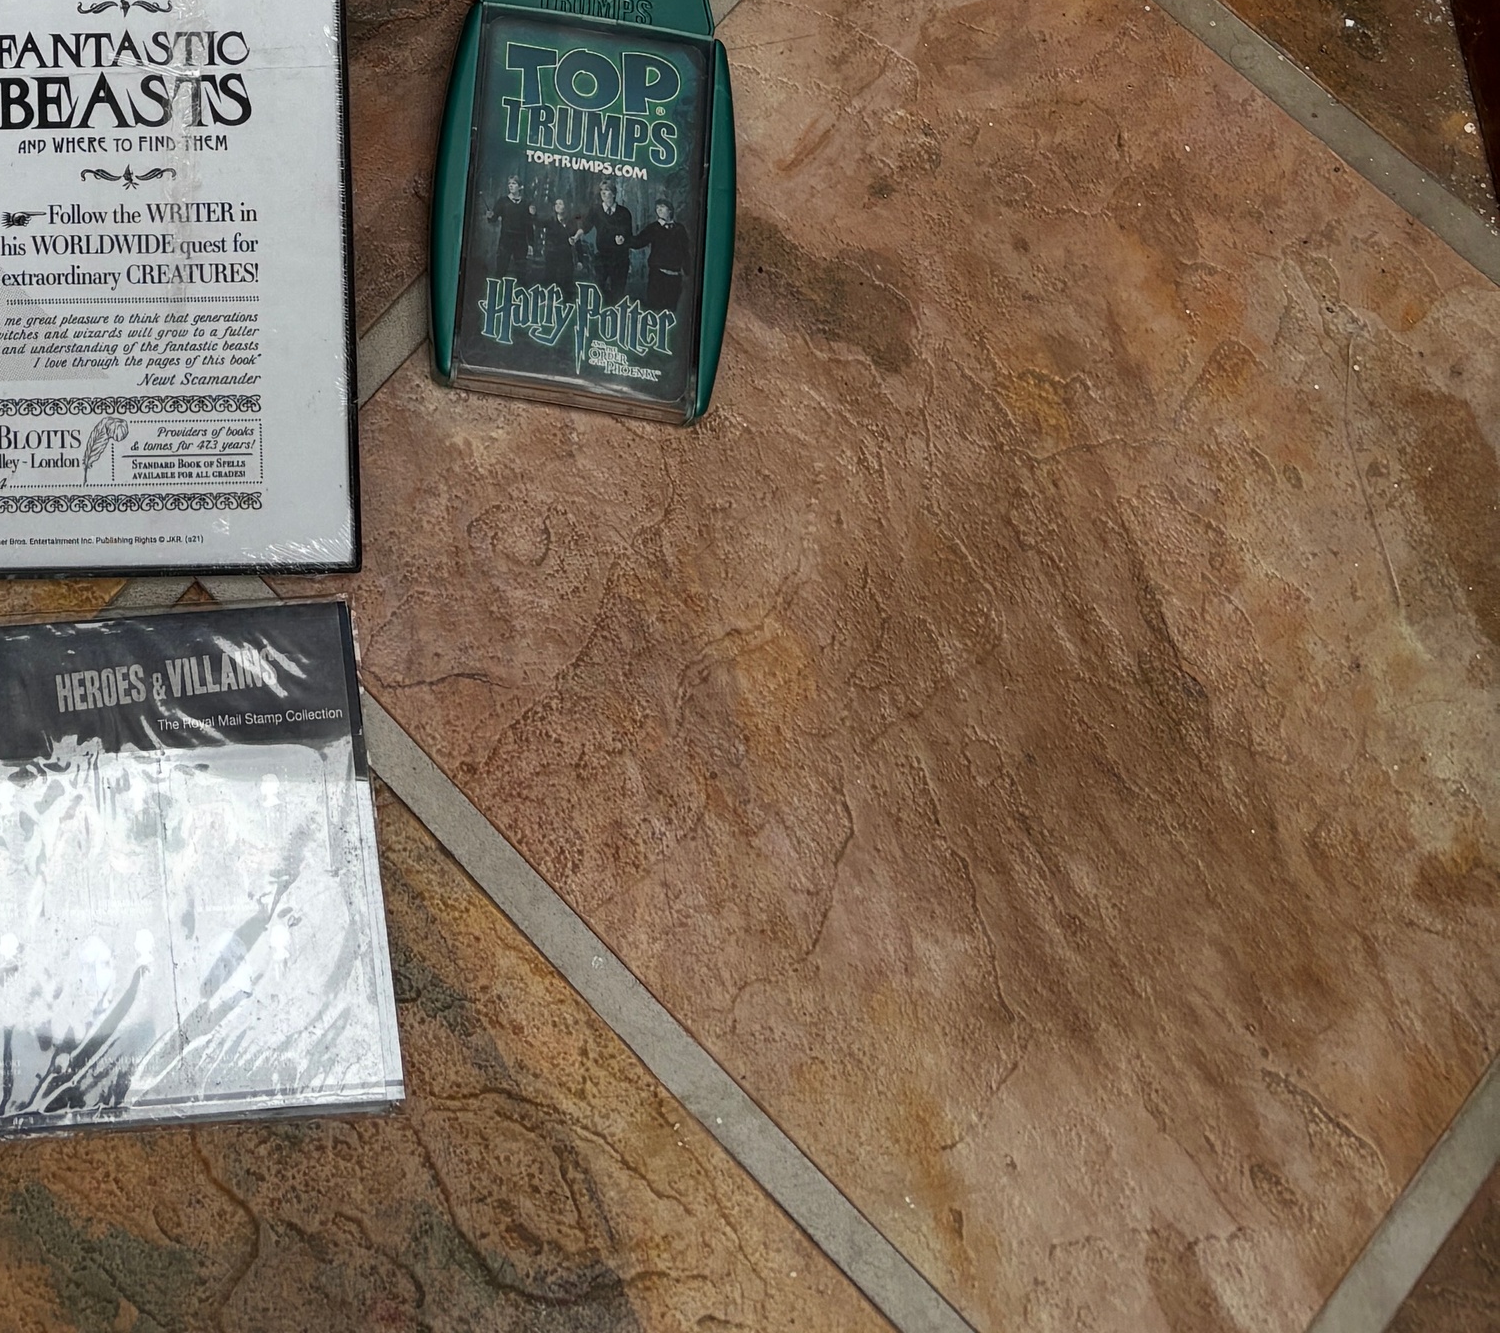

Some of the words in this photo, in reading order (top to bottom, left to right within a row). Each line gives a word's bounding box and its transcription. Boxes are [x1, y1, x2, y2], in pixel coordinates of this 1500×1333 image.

[504, 41, 681, 115] TOP
[501, 96, 678, 168] TRUMPS
[526, 150, 648, 181] TOPTRUMPS.COM
[47, 204, 107, 225] Follow
[113, 204, 141, 223] the
[146, 202, 235, 223] WRITER
[240, 202, 257, 222] in
[1, 236, 26, 256] his
[30, 234, 175, 255] WORLDWIDE
[180, 238, 227, 259] quest
[233, 233, 258, 253] for
[2, 265, 121, 290] extraordinary
[126, 263, 258, 284] CREATURES!
[478, 277, 574, 346] Harry
[574, 282, 676, 374] Potter
[30, 453, 80, 469] London
[56, 663, 147, 713] HEROES
[152, 672, 166, 700] &
[166, 647, 278, 698] VILLAINS
[158, 719, 179, 731] The
[182, 717, 215, 731] Royal
[218, 714, 242, 727] Mail
[245, 711, 282, 727] Stamp
[286, 707, 343, 721] Collection
